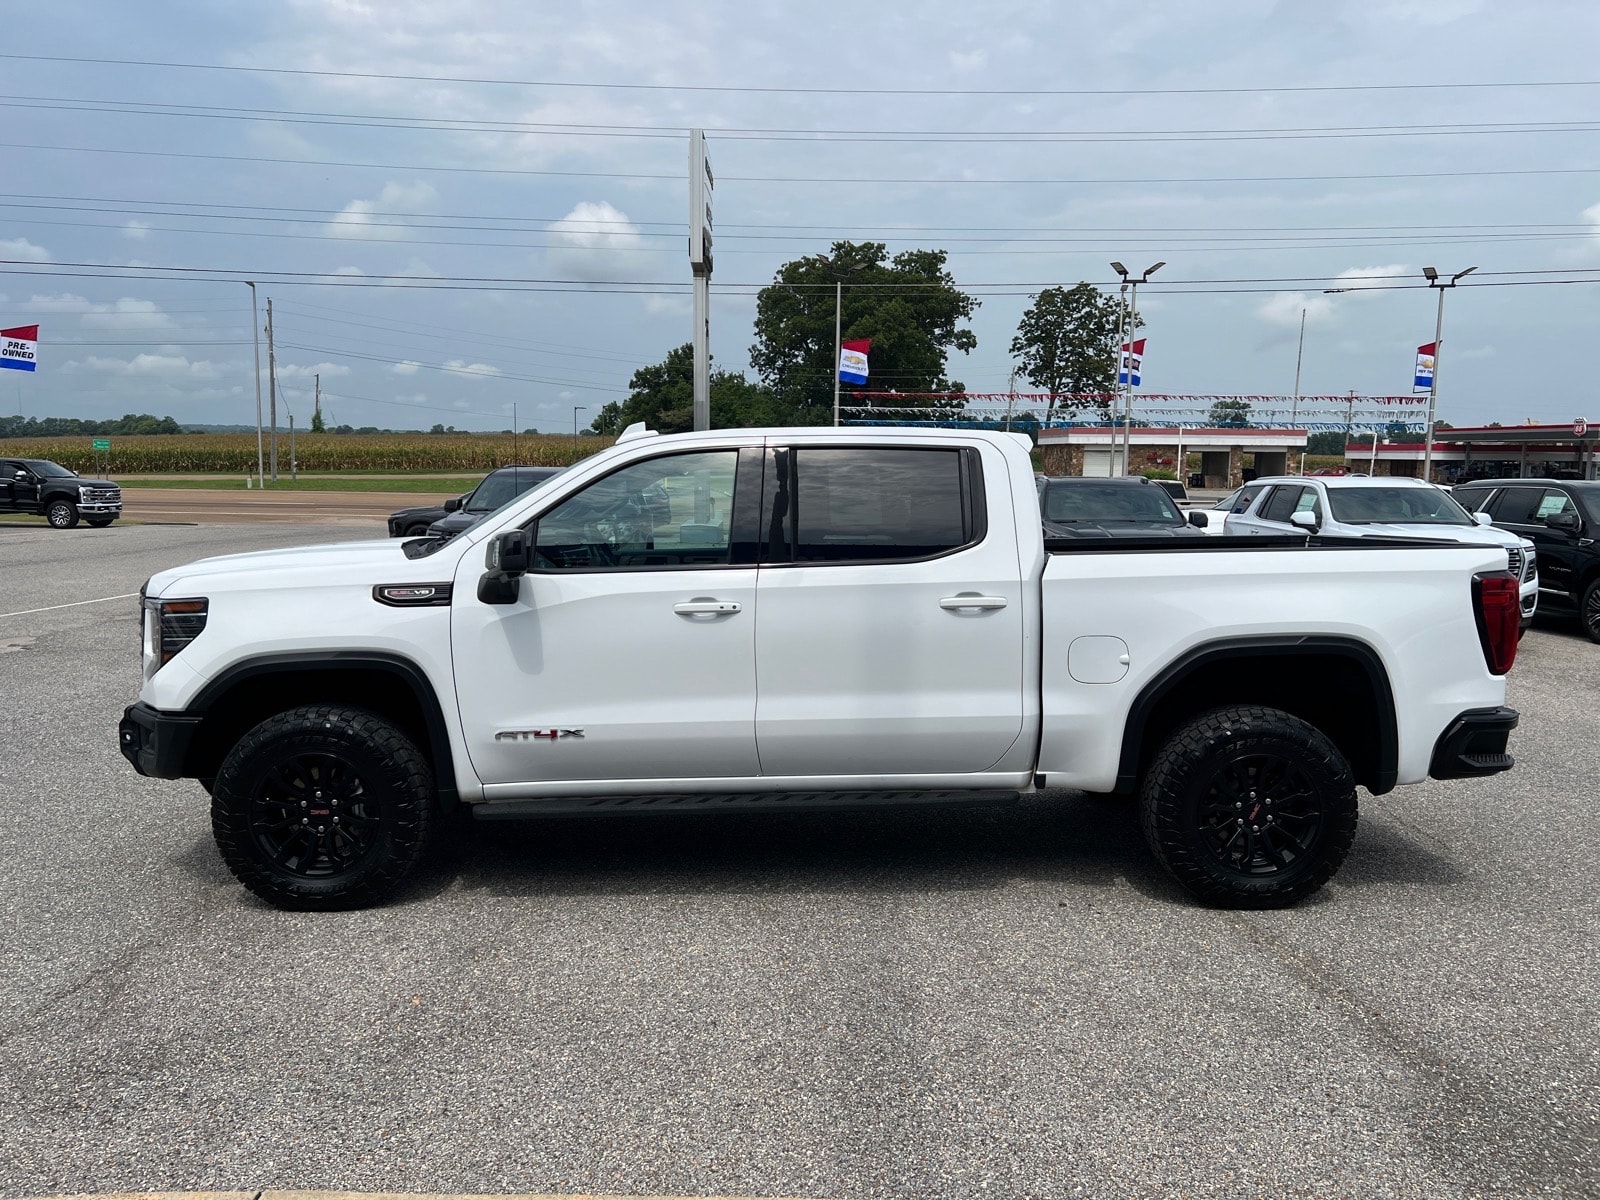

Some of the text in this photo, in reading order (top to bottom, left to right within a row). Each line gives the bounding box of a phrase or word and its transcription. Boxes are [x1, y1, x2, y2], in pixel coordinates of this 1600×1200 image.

[7, 341, 30, 350] PRE-
[2, 348, 34, 359] OWNED
[495, 729, 585, 740] AT4X
